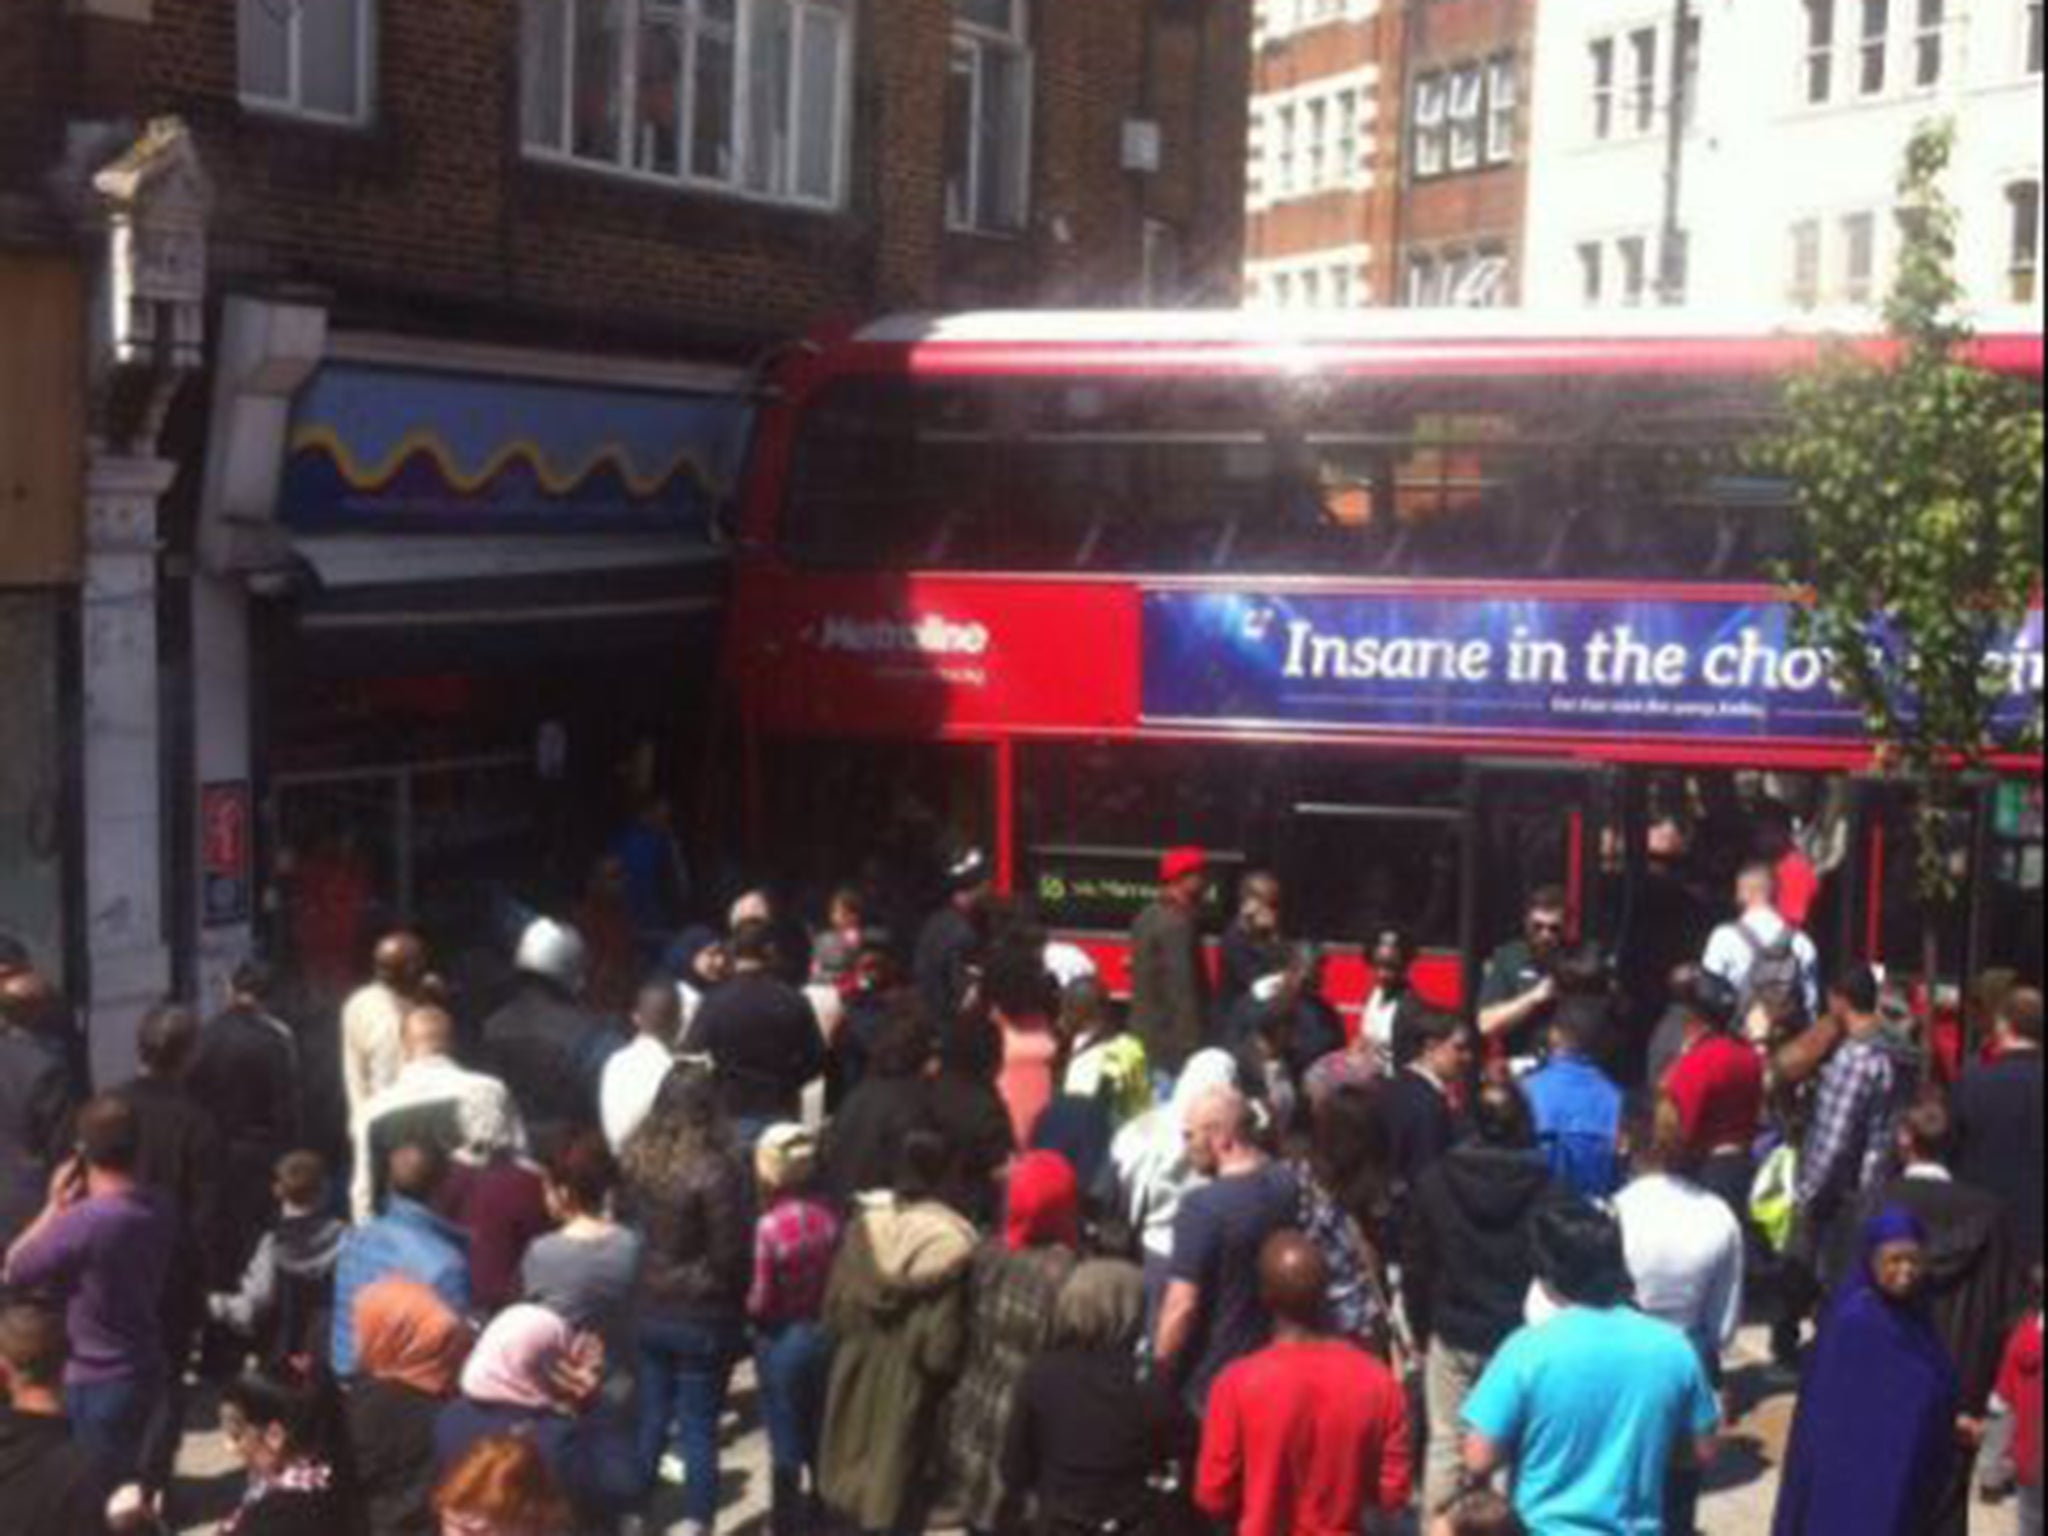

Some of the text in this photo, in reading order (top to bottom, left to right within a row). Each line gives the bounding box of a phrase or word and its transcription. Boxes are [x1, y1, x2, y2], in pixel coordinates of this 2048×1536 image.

[1281, 617, 1492, 681] Insane
[1507, 625, 1569, 684] in
[1585, 623, 1688, 689] the
